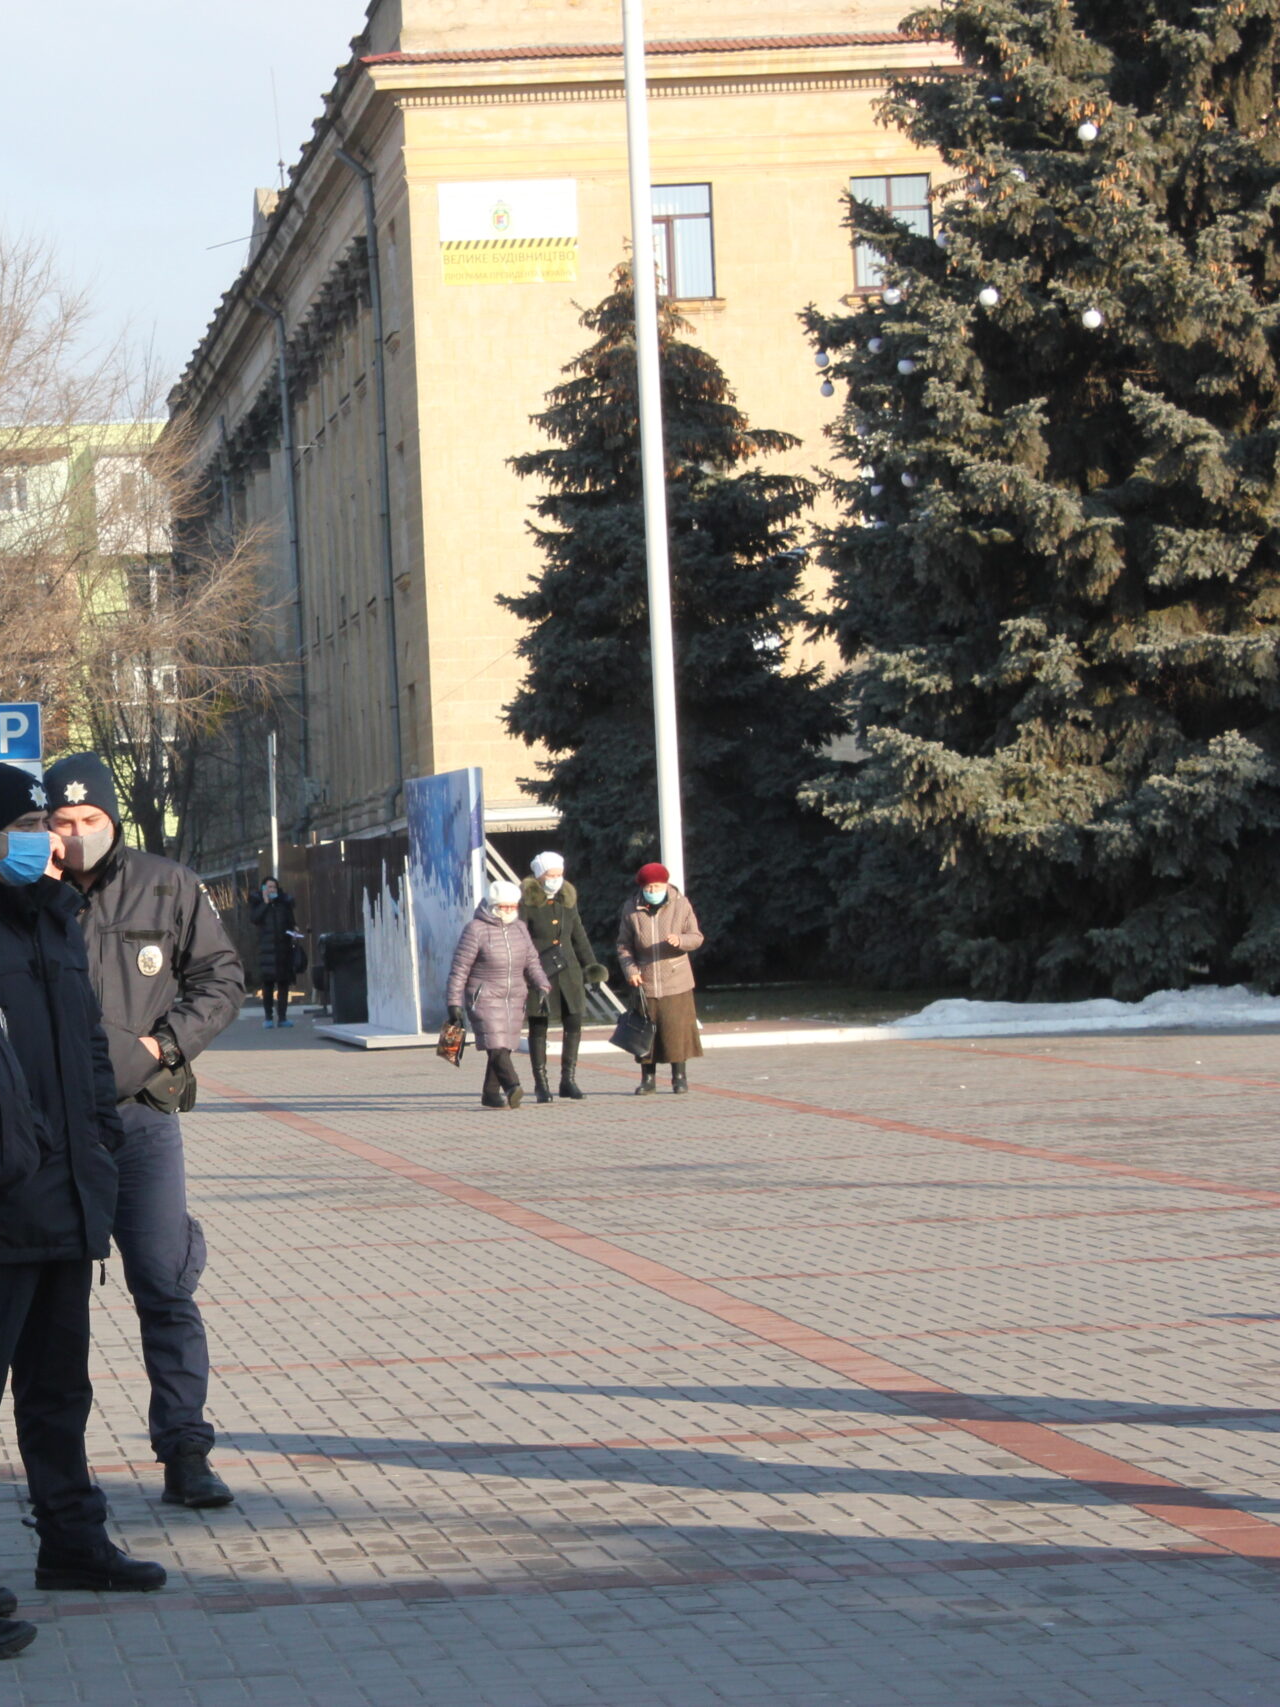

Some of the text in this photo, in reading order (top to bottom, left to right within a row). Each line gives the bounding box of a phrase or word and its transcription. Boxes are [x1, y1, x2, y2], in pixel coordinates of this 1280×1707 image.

[443, 250, 576, 265] ВЕЛИКЕ БУДІВНИЦТВО
[0, 711, 29, 754] P
